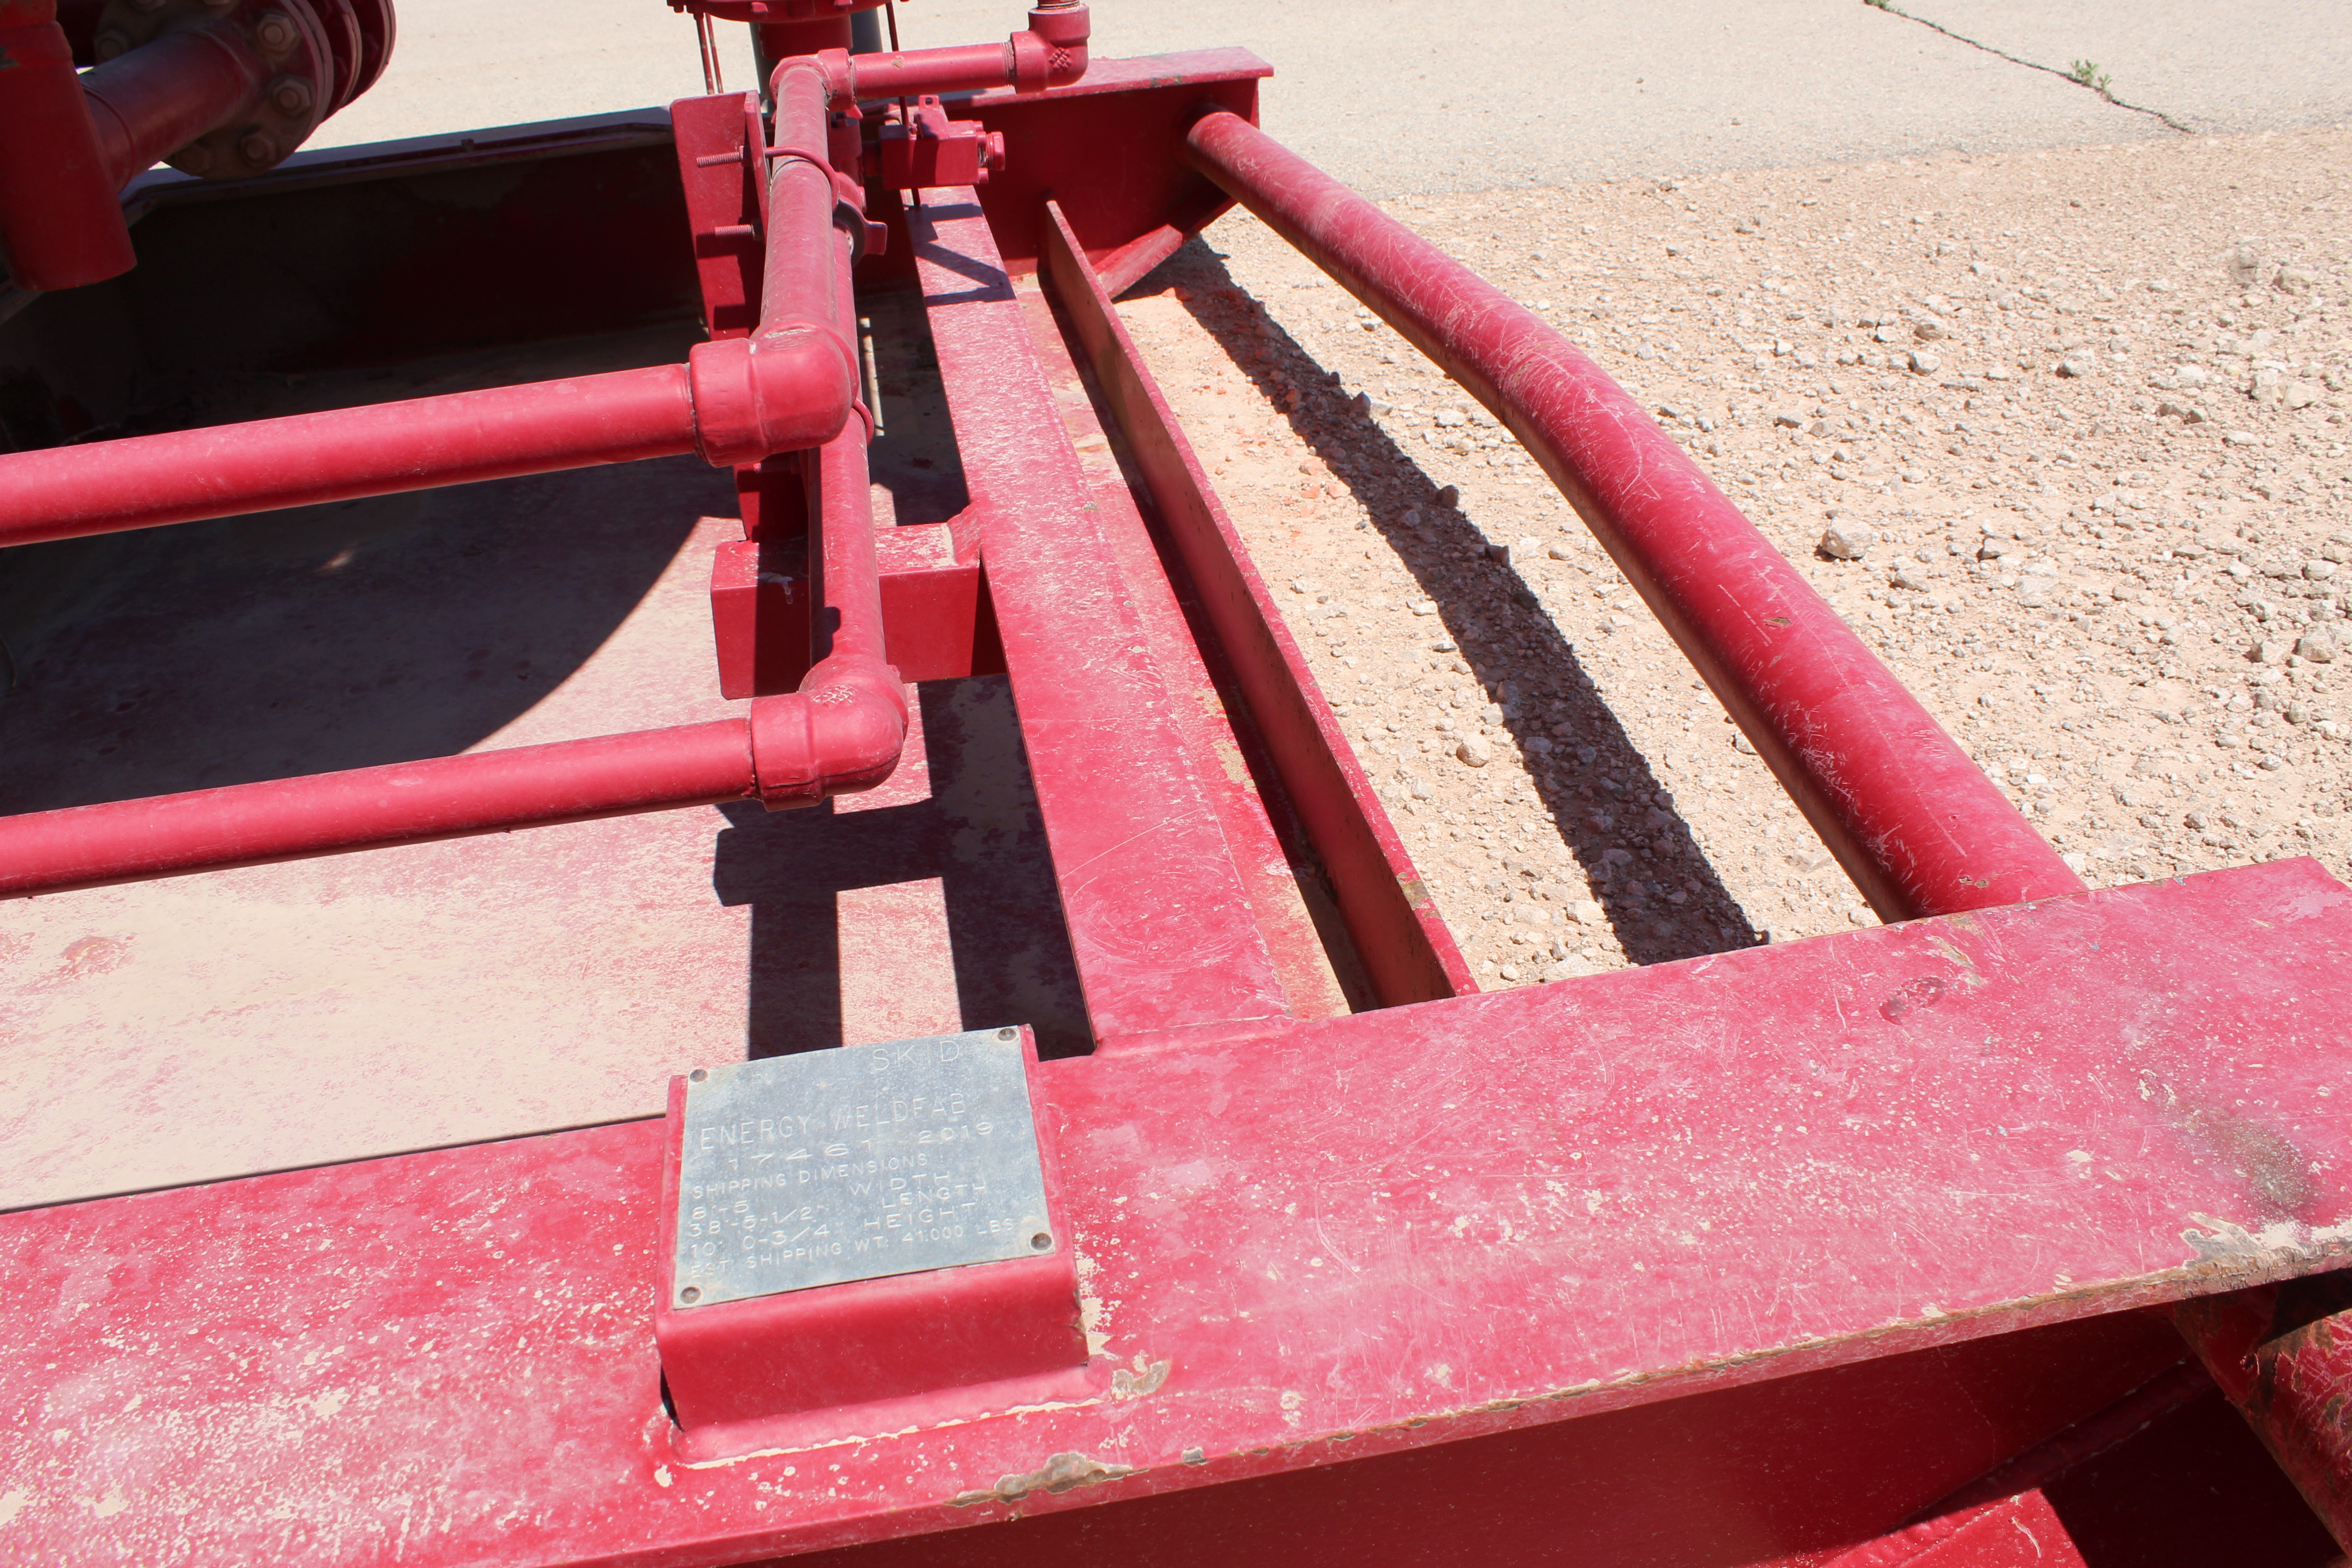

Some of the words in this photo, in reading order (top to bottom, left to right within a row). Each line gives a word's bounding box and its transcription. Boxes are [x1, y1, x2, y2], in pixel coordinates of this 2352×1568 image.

[872, 1040, 959, 1071] SKID
[701, 1113, 812, 1150] ENERGY
[831, 1093, 965, 1130] WELDFAB
[917, 1122, 993, 1144] 2019
[692, 1173, 787, 1199] SHIPPING
[849, 1171, 950, 1196] WIDTH
[882, 1182, 988, 1208] LENGTH
[864, 1202, 976, 1229] HEIGHT
[746, 1242, 842, 1269] SHIPPING
